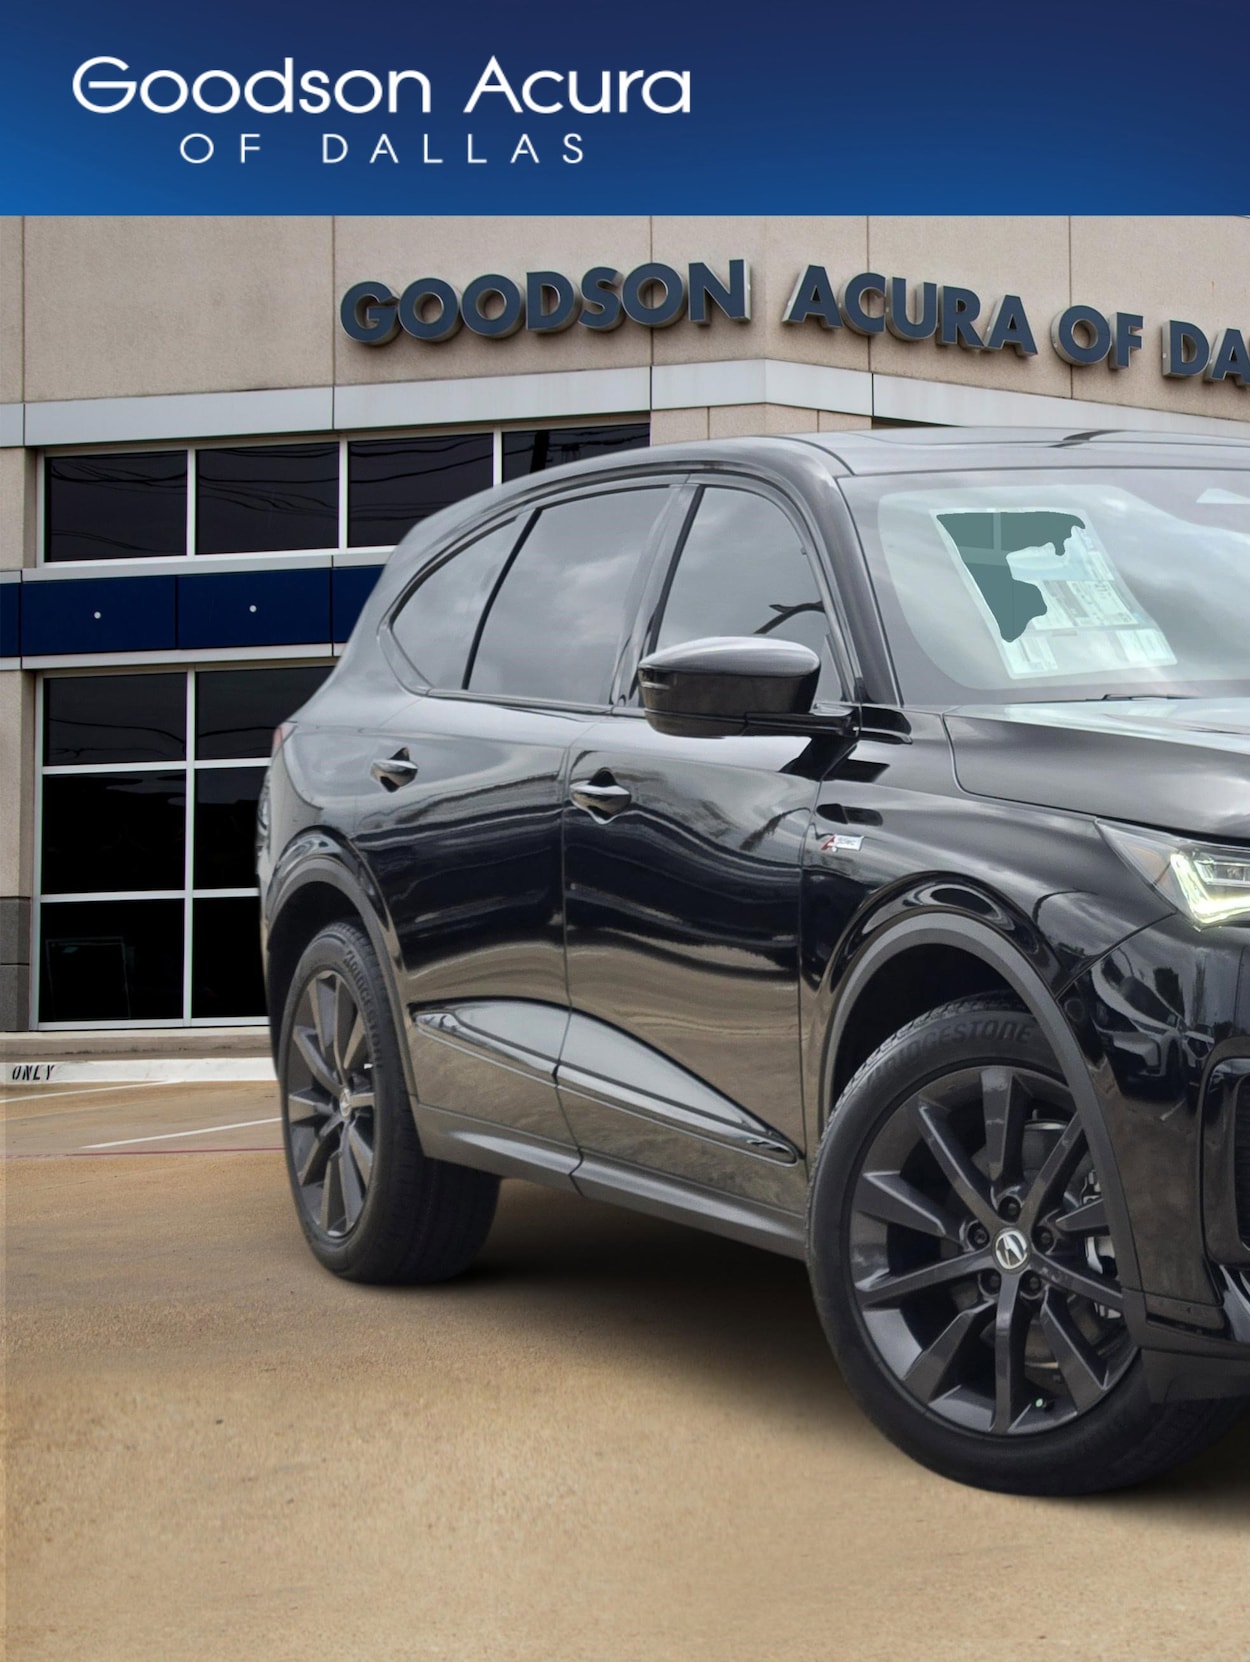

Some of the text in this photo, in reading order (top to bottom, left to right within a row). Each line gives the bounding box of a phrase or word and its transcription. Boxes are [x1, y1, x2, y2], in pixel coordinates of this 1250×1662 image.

[340, 259, 751, 345] GOODSON
[782, 264, 1038, 356] ACURA
[1051, 304, 1143, 369] OF
[12, 1064, 55, 1081] ONLY
